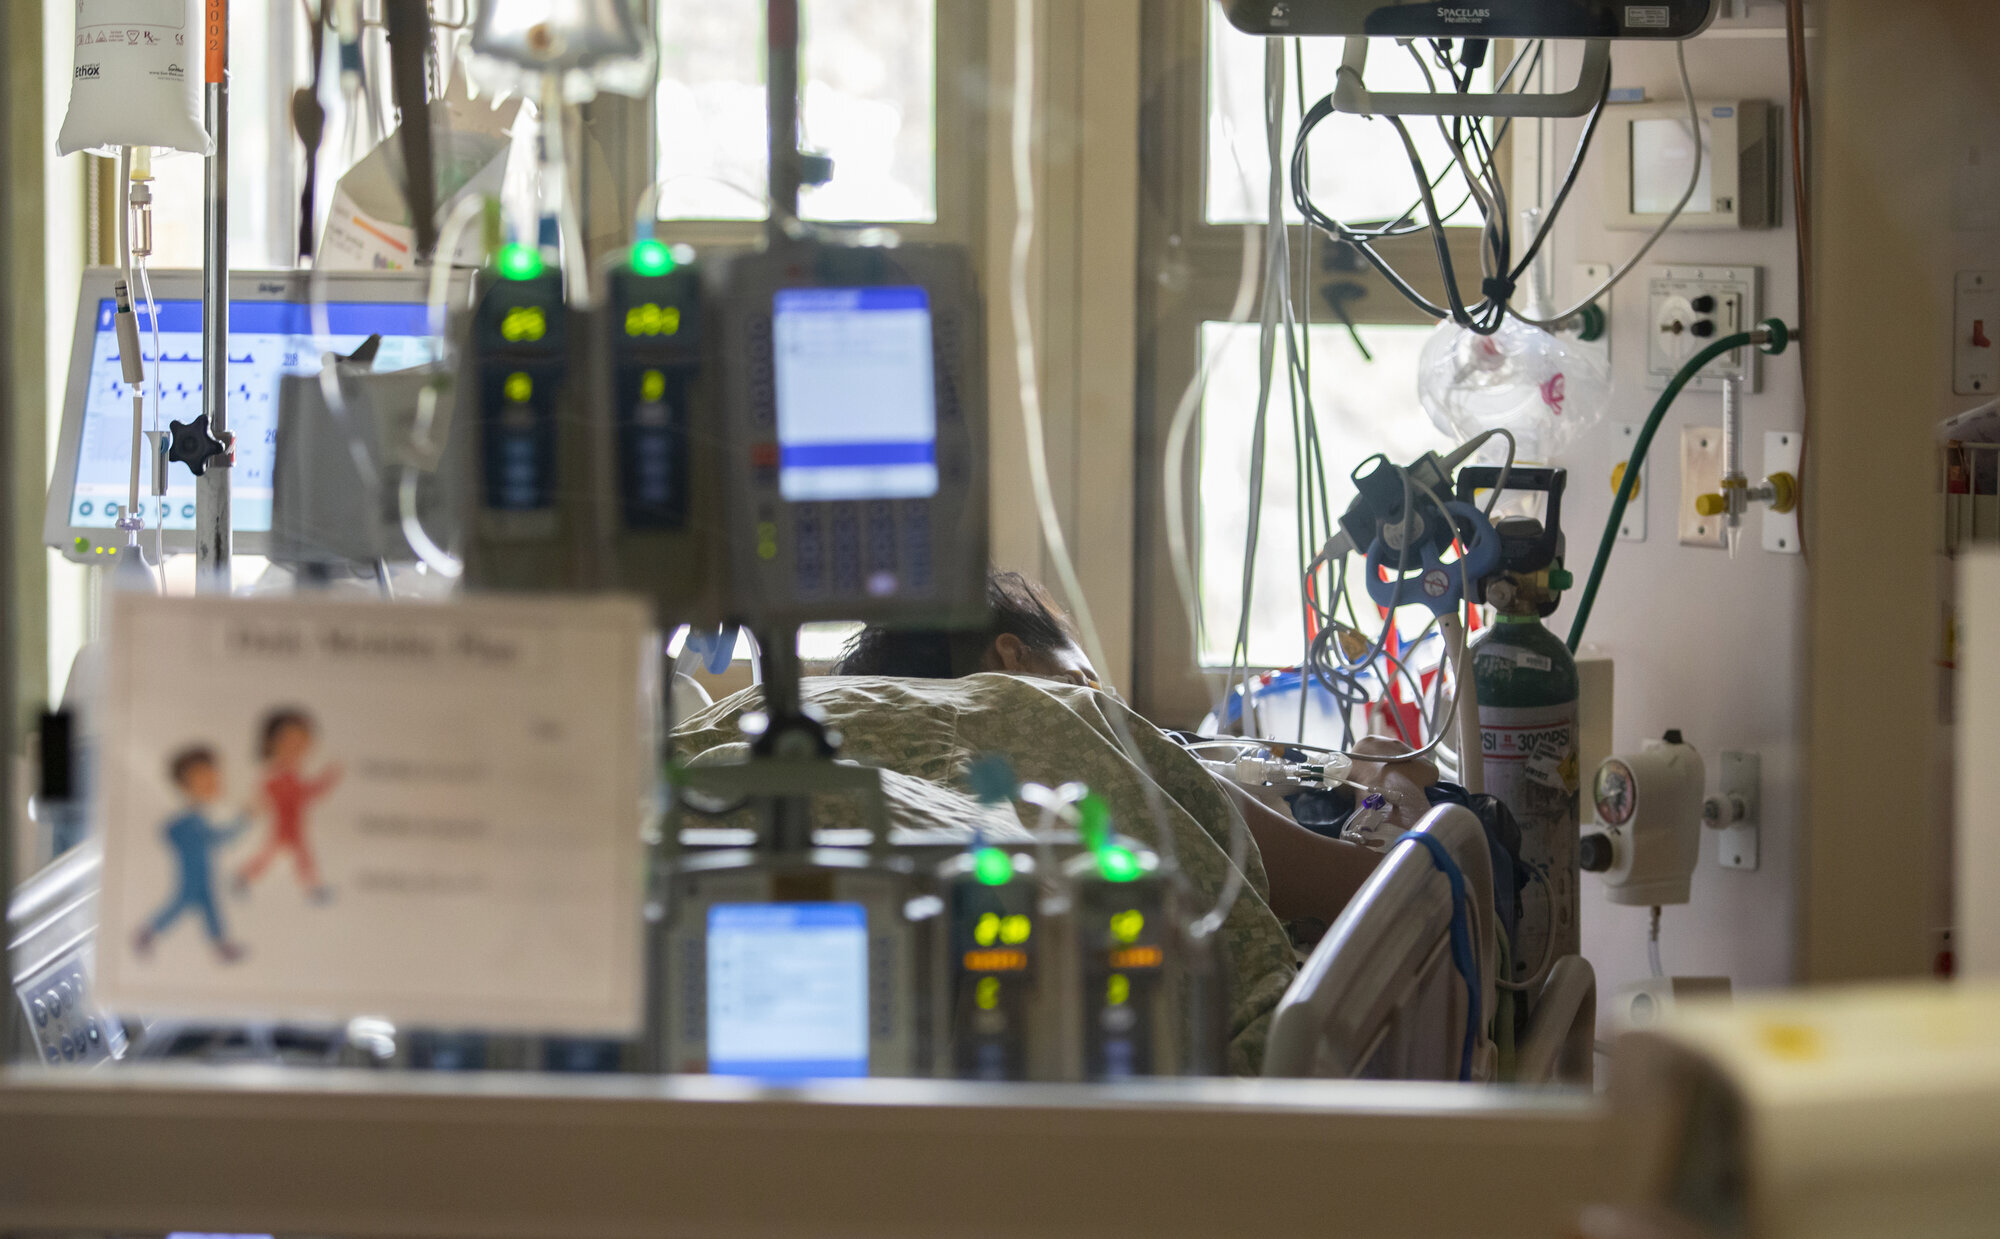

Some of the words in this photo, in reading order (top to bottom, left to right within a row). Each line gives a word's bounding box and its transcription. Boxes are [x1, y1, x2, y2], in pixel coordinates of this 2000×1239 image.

[1437, 7, 1490, 17] SPACELABS
[75, 66, 100, 78] Ethox
[1480, 732, 1497, 751] SI
